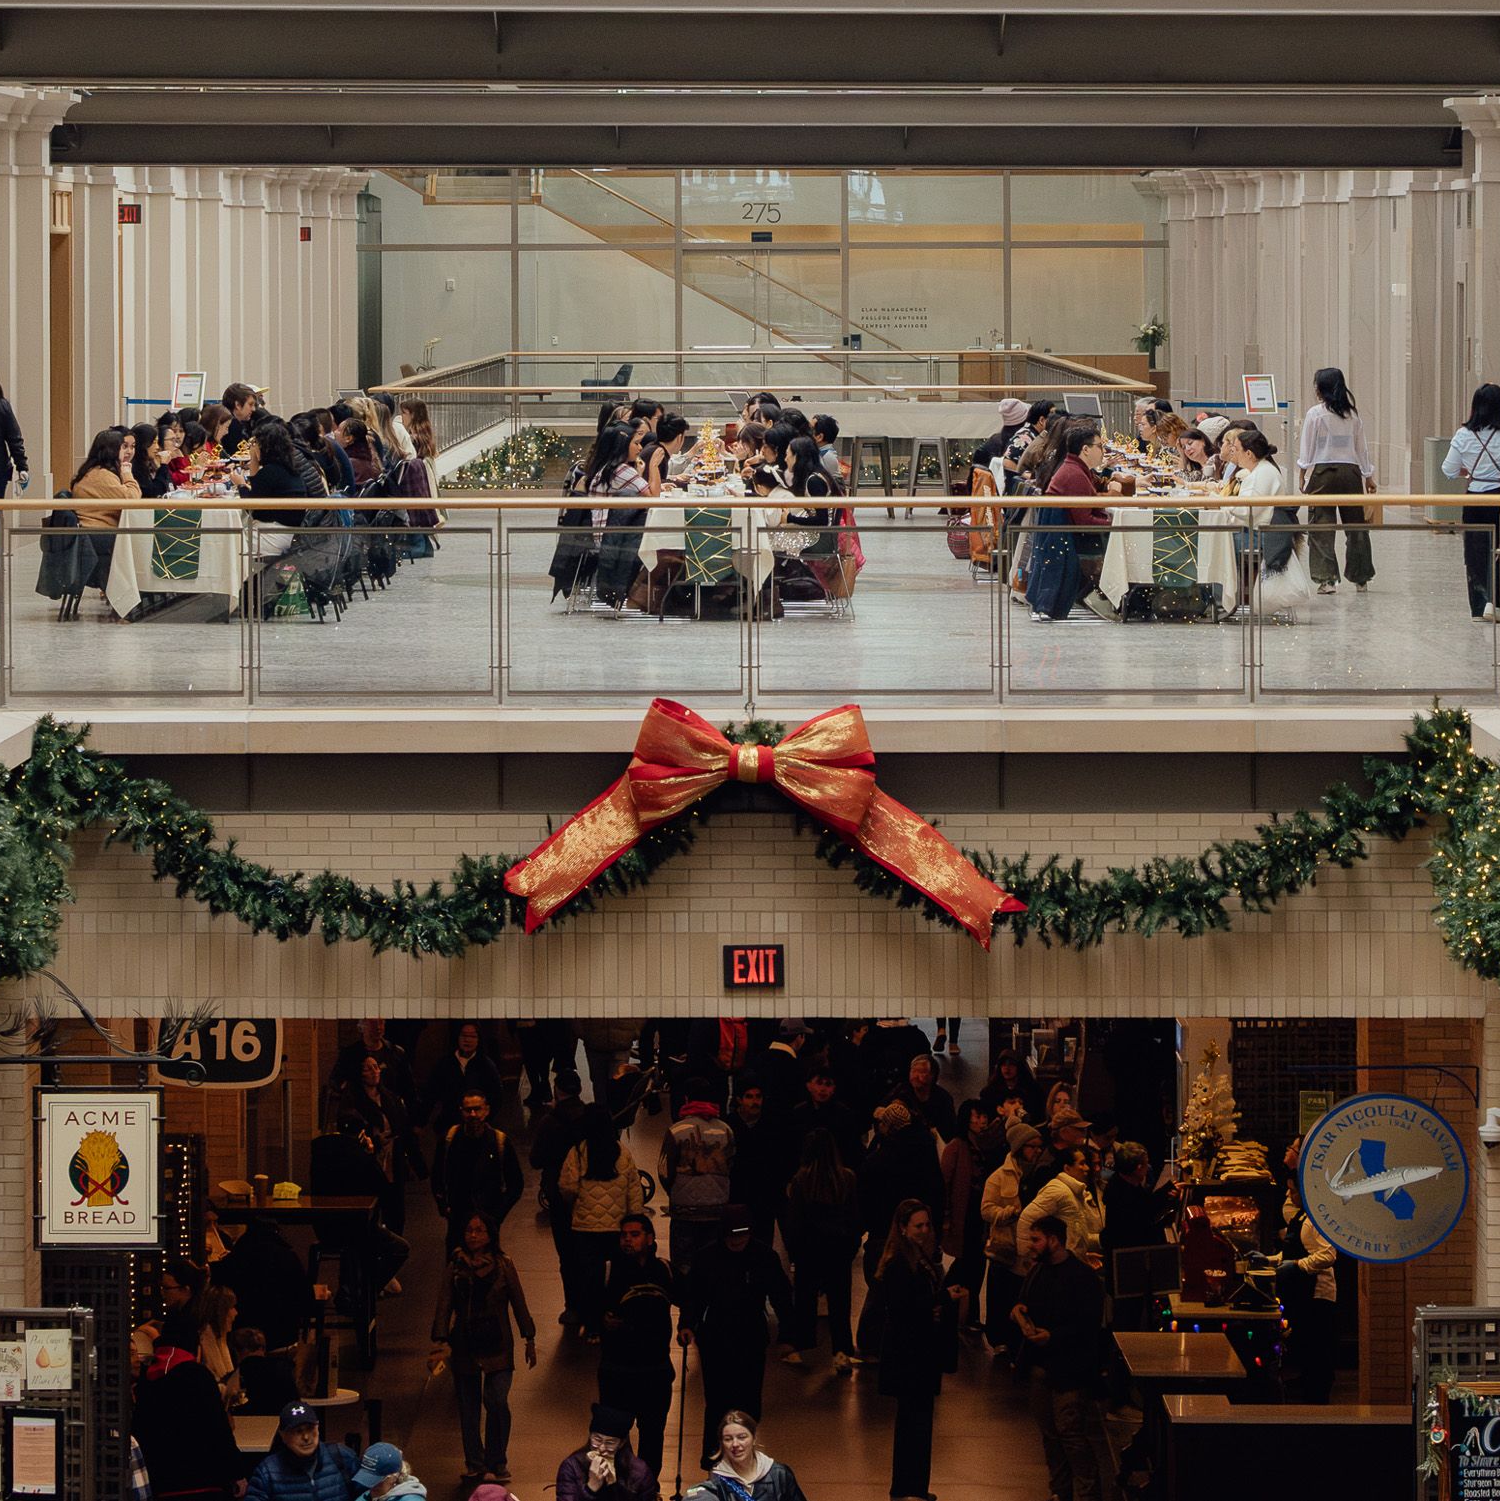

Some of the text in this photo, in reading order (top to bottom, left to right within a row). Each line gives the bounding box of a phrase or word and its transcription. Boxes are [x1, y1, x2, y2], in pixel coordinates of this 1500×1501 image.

[742, 202, 781, 223] 275
[733, 949, 777, 984] EXIT
[171, 1020, 262, 1062] A16
[64, 1110, 136, 1126] ACME
[1310, 1131, 1337, 1172] TSAR
[64, 1211, 136, 1225] BREAD
[1463, 1468, 1496, 1478] Everything
[1463, 1479, 1493, 1488] Sturgeon
[1463, 1488, 1490, 1498] Roasted
